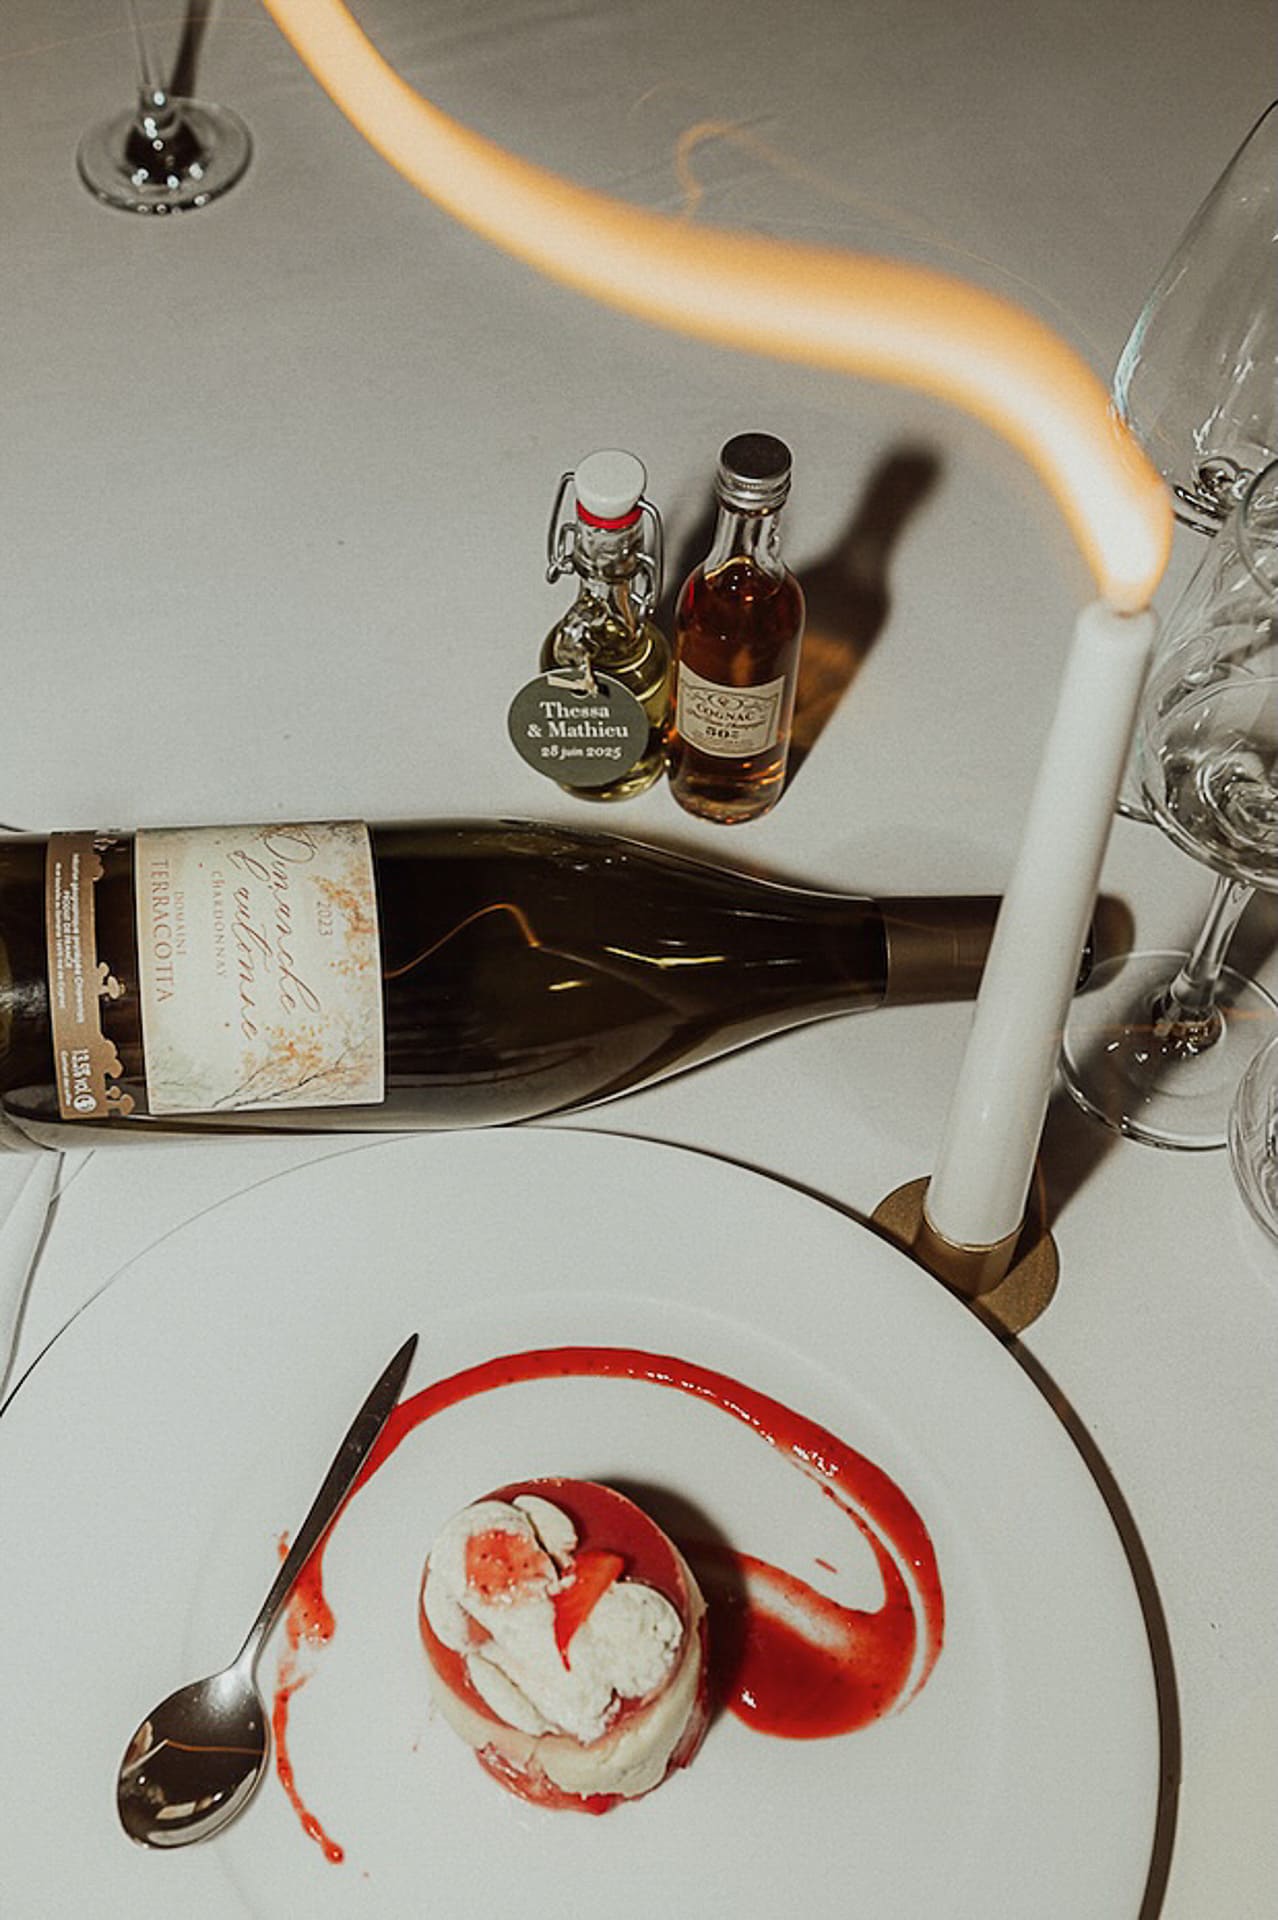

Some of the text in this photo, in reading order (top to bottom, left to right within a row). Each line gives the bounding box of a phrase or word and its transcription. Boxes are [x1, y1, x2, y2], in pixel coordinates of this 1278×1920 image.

[540, 701, 610, 719] Thessa
[695, 702, 755, 722] COGNAC
[526, 721, 630, 738] & Mathieu
[540, 745, 622, 760] 28 juin 2025
[150, 859, 174, 1003] TERRACOTTA
[173, 890, 187, 956] DOMAINE
[262, 829, 322, 1016] Dimanche
[316, 900, 333, 937] 2023
